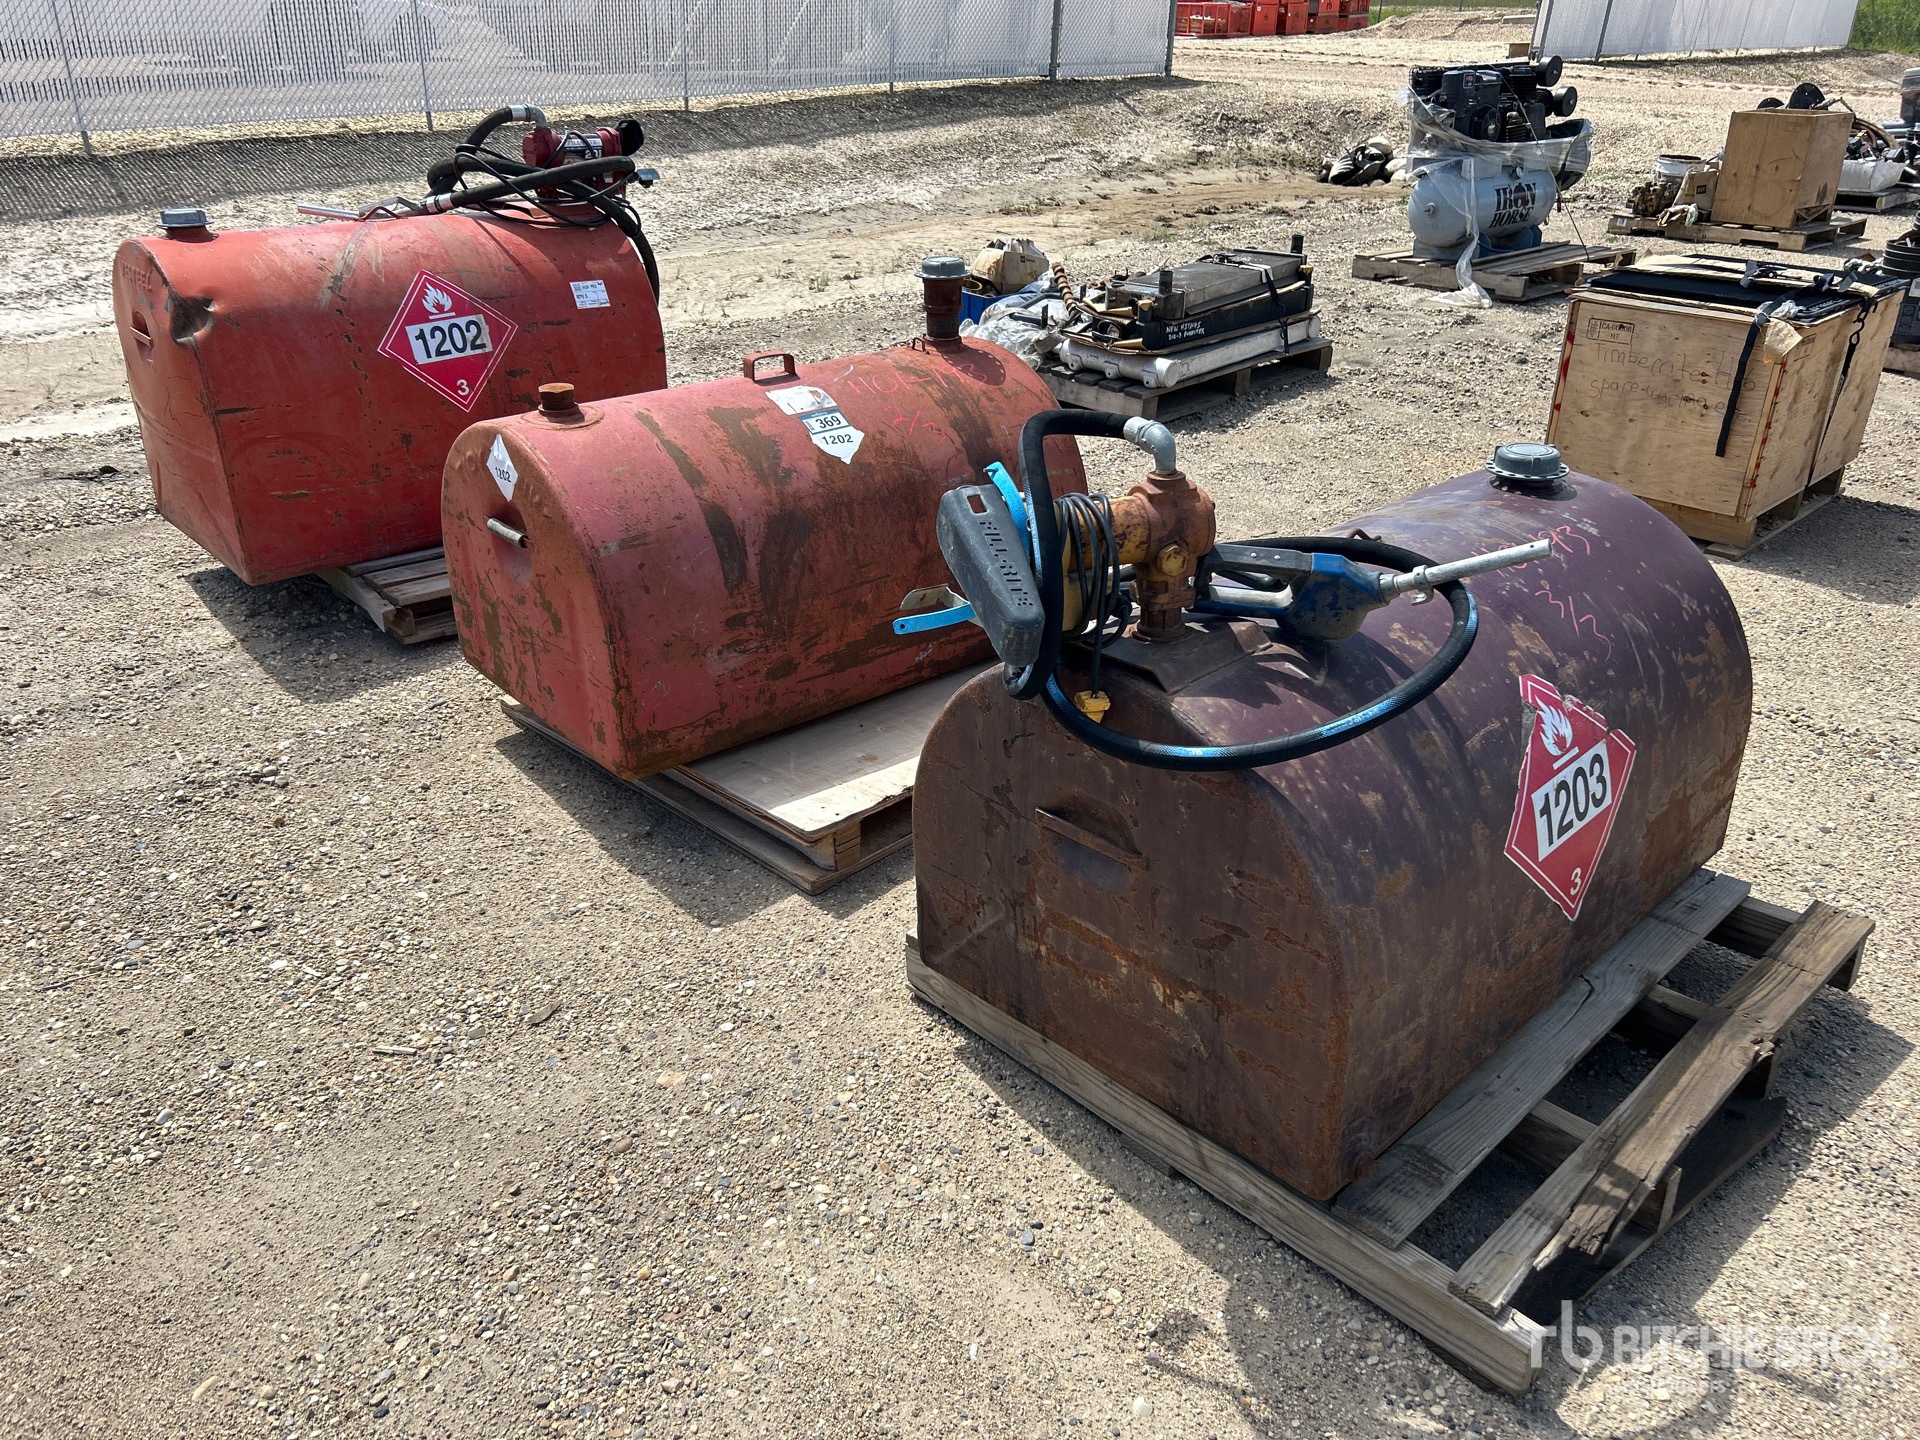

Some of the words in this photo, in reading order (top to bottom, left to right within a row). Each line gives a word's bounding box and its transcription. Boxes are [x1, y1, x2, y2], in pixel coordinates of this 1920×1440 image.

[1494, 183, 1536, 212] IRON
[1488, 206, 1534, 228] HORSE
[414, 319, 487, 359] 1202
[456, 379, 470, 396] 3
[815, 415, 842, 430] 369
[884, 406, 946, 446] 2/3
[822, 433, 854, 446] 1202
[979, 520, 1034, 607] FILL-RITE
[1539, 753, 1608, 848] 1203
[1569, 867, 1582, 896] 3
